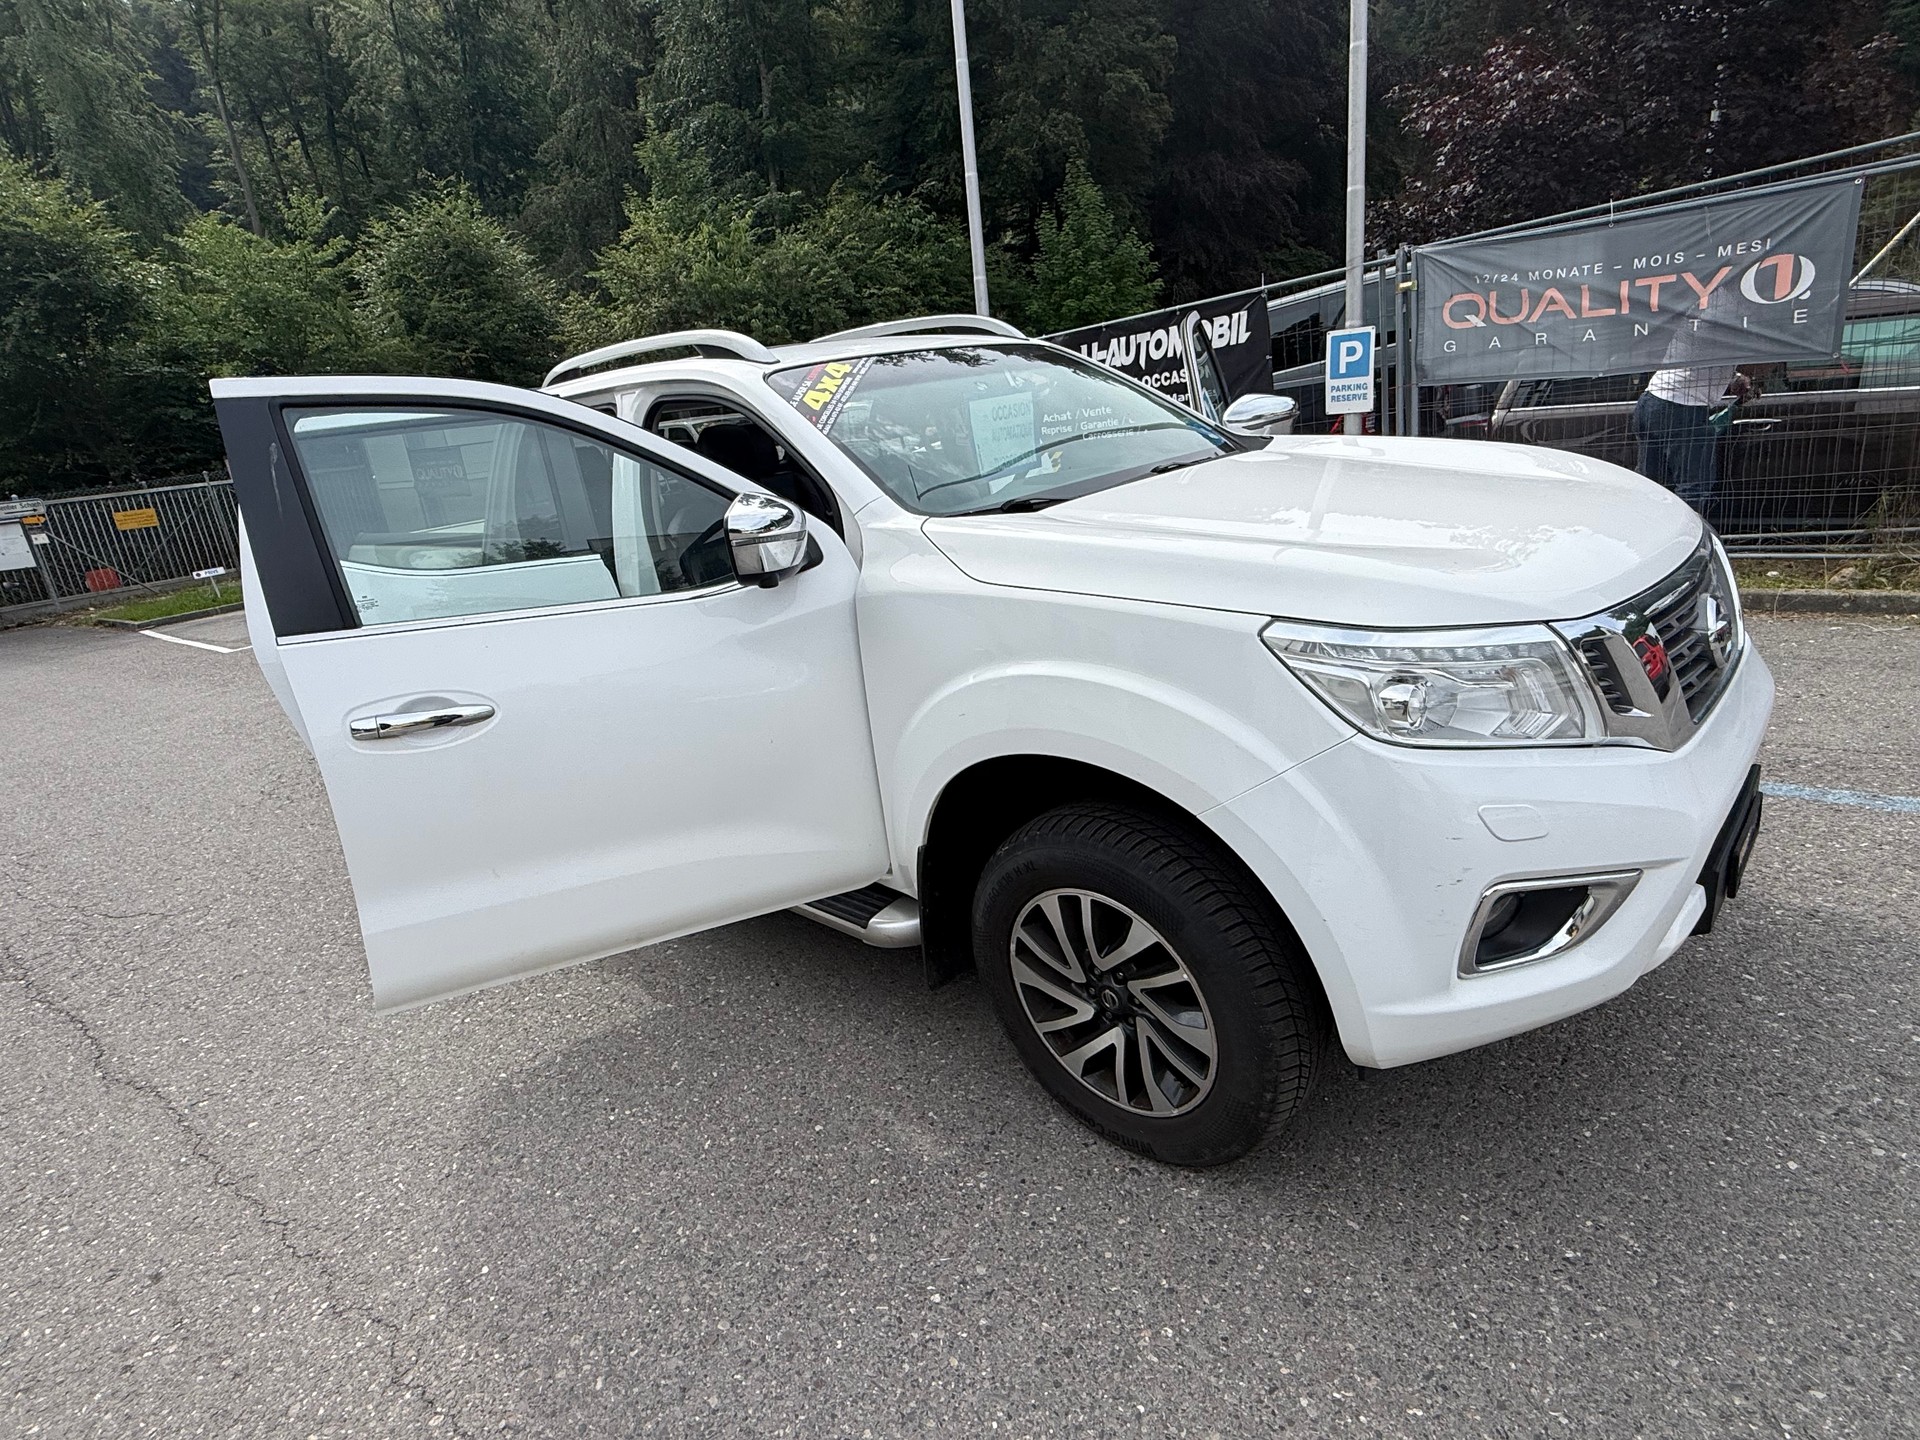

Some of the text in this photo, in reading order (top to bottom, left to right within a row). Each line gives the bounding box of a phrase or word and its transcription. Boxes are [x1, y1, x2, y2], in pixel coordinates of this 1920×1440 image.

[1474, 273, 1519, 284] 12/24
[1528, 263, 1603, 281] MONATE
[1633, 252, 1684, 270] MOIS
[1717, 238, 1771, 258] MESI
[1442, 265, 1733, 329] QUALITY
[1443, 308, 1808, 353] GARANTIE
[1339, 340, 1364, 374] P
[1330, 382, 1368, 393] PARKING
[1330, 392, 1368, 403] RESERVE
[1042, 410, 1073, 423] Achat
[1082, 405, 1112, 418] Vente
[1041, 423, 1073, 436] Reprise
[1080, 417, 1119, 431] Garantie
[1082, 428, 1135, 441] Carrosserie
